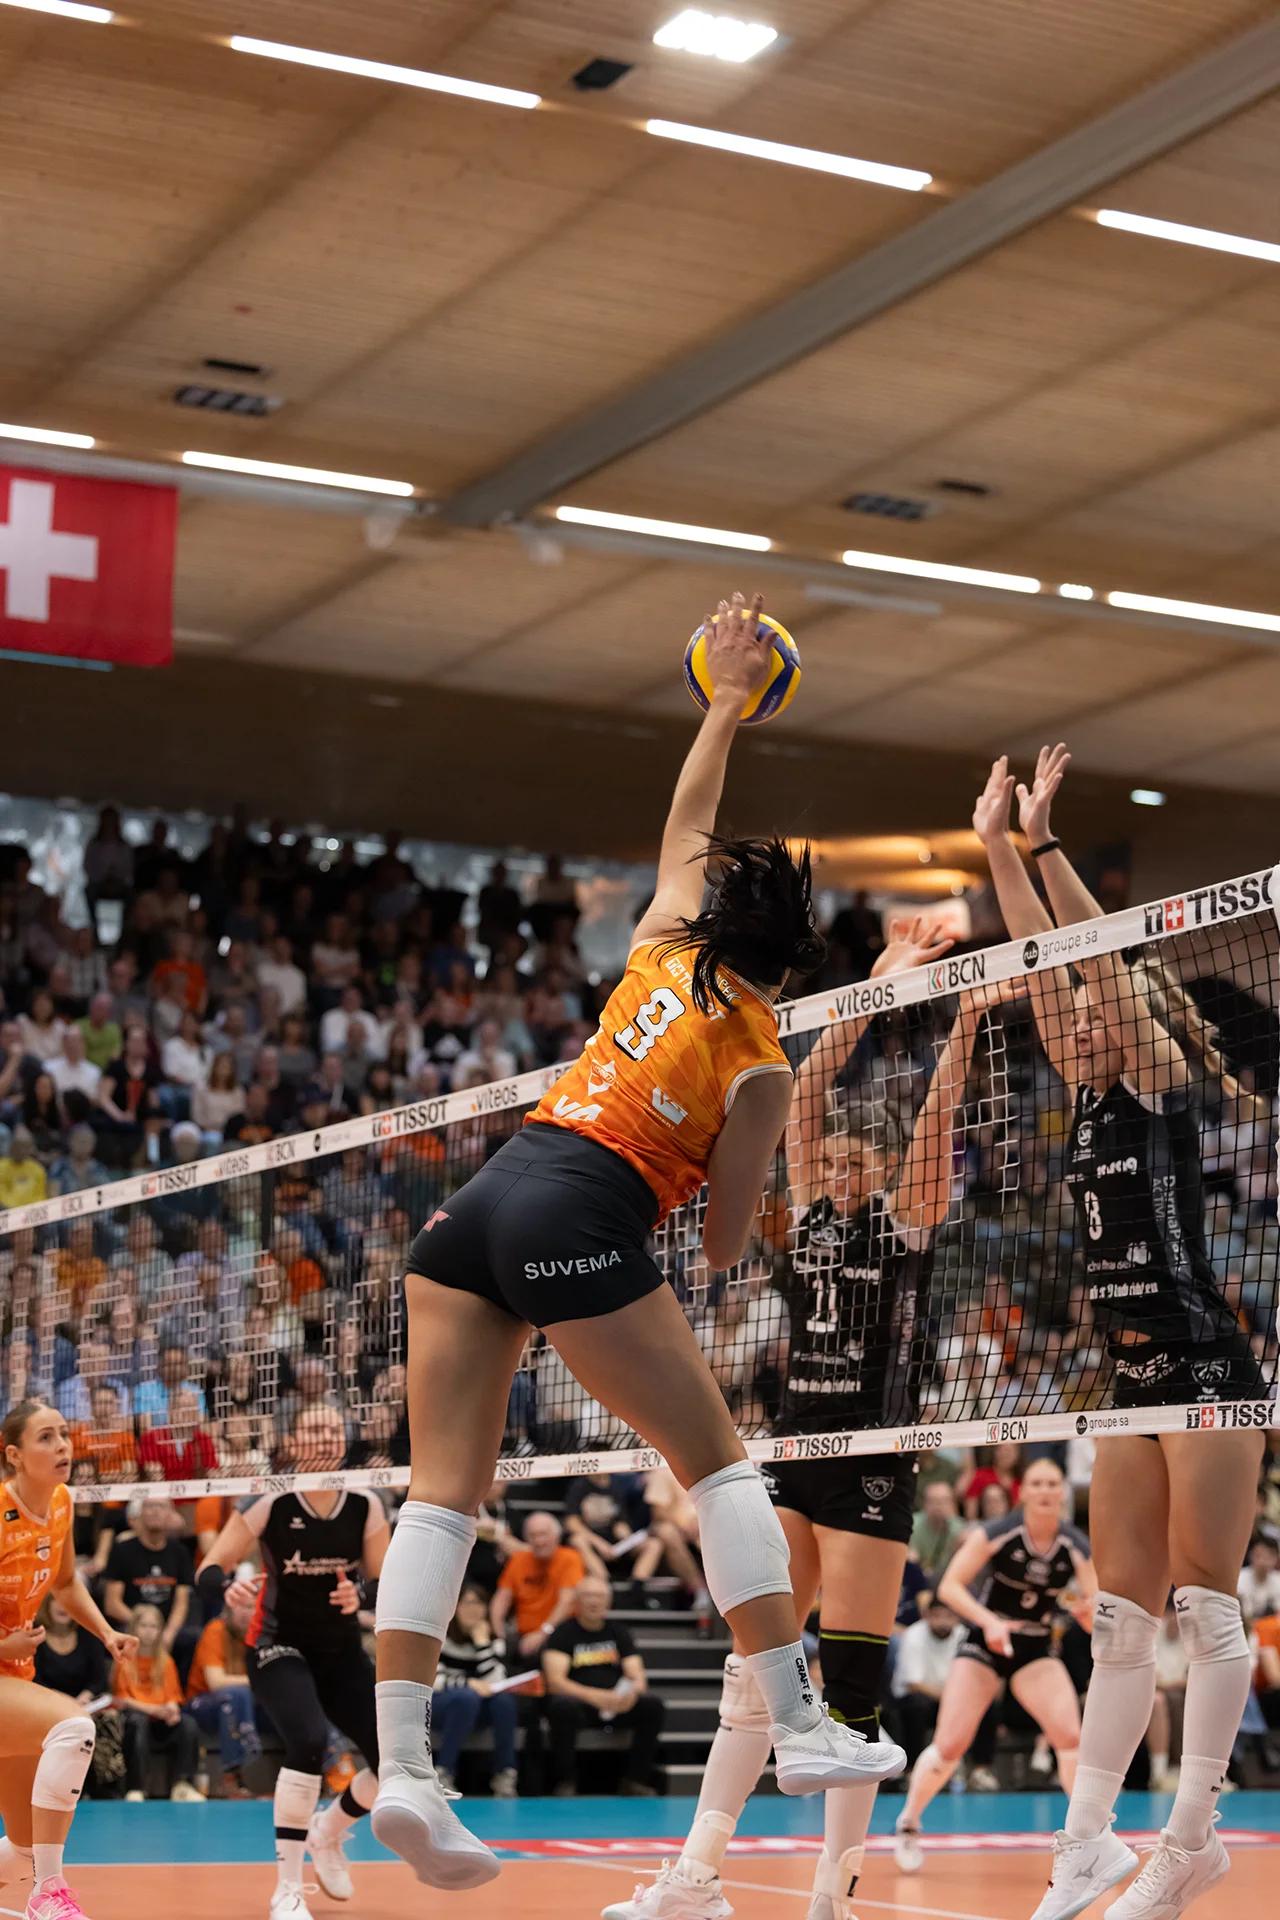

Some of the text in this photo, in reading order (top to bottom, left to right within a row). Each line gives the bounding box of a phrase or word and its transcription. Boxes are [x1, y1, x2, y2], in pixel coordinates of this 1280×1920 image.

[835, 983, 895, 1018] viteos
[948, 954, 986, 988] BCN
[1042, 936, 1081, 962] groupe
[1085, 930, 1098, 945] sa
[613, 986, 686, 1062] 9
[394, 1084, 519, 1133] TISSOT viteos
[524, 1250, 622, 1280] SUVEMA
[796, 1435, 853, 1457] TISSOT
[900, 1430, 943, 1450] viteos
[1001, 1420, 1029, 1441] BCN
[1089, 1417, 1118, 1432] groupe
[1120, 1416, 1129, 1427] sa
[568, 1457, 600, 1474] viteos
[796, 1657, 810, 1690] CRAFT
